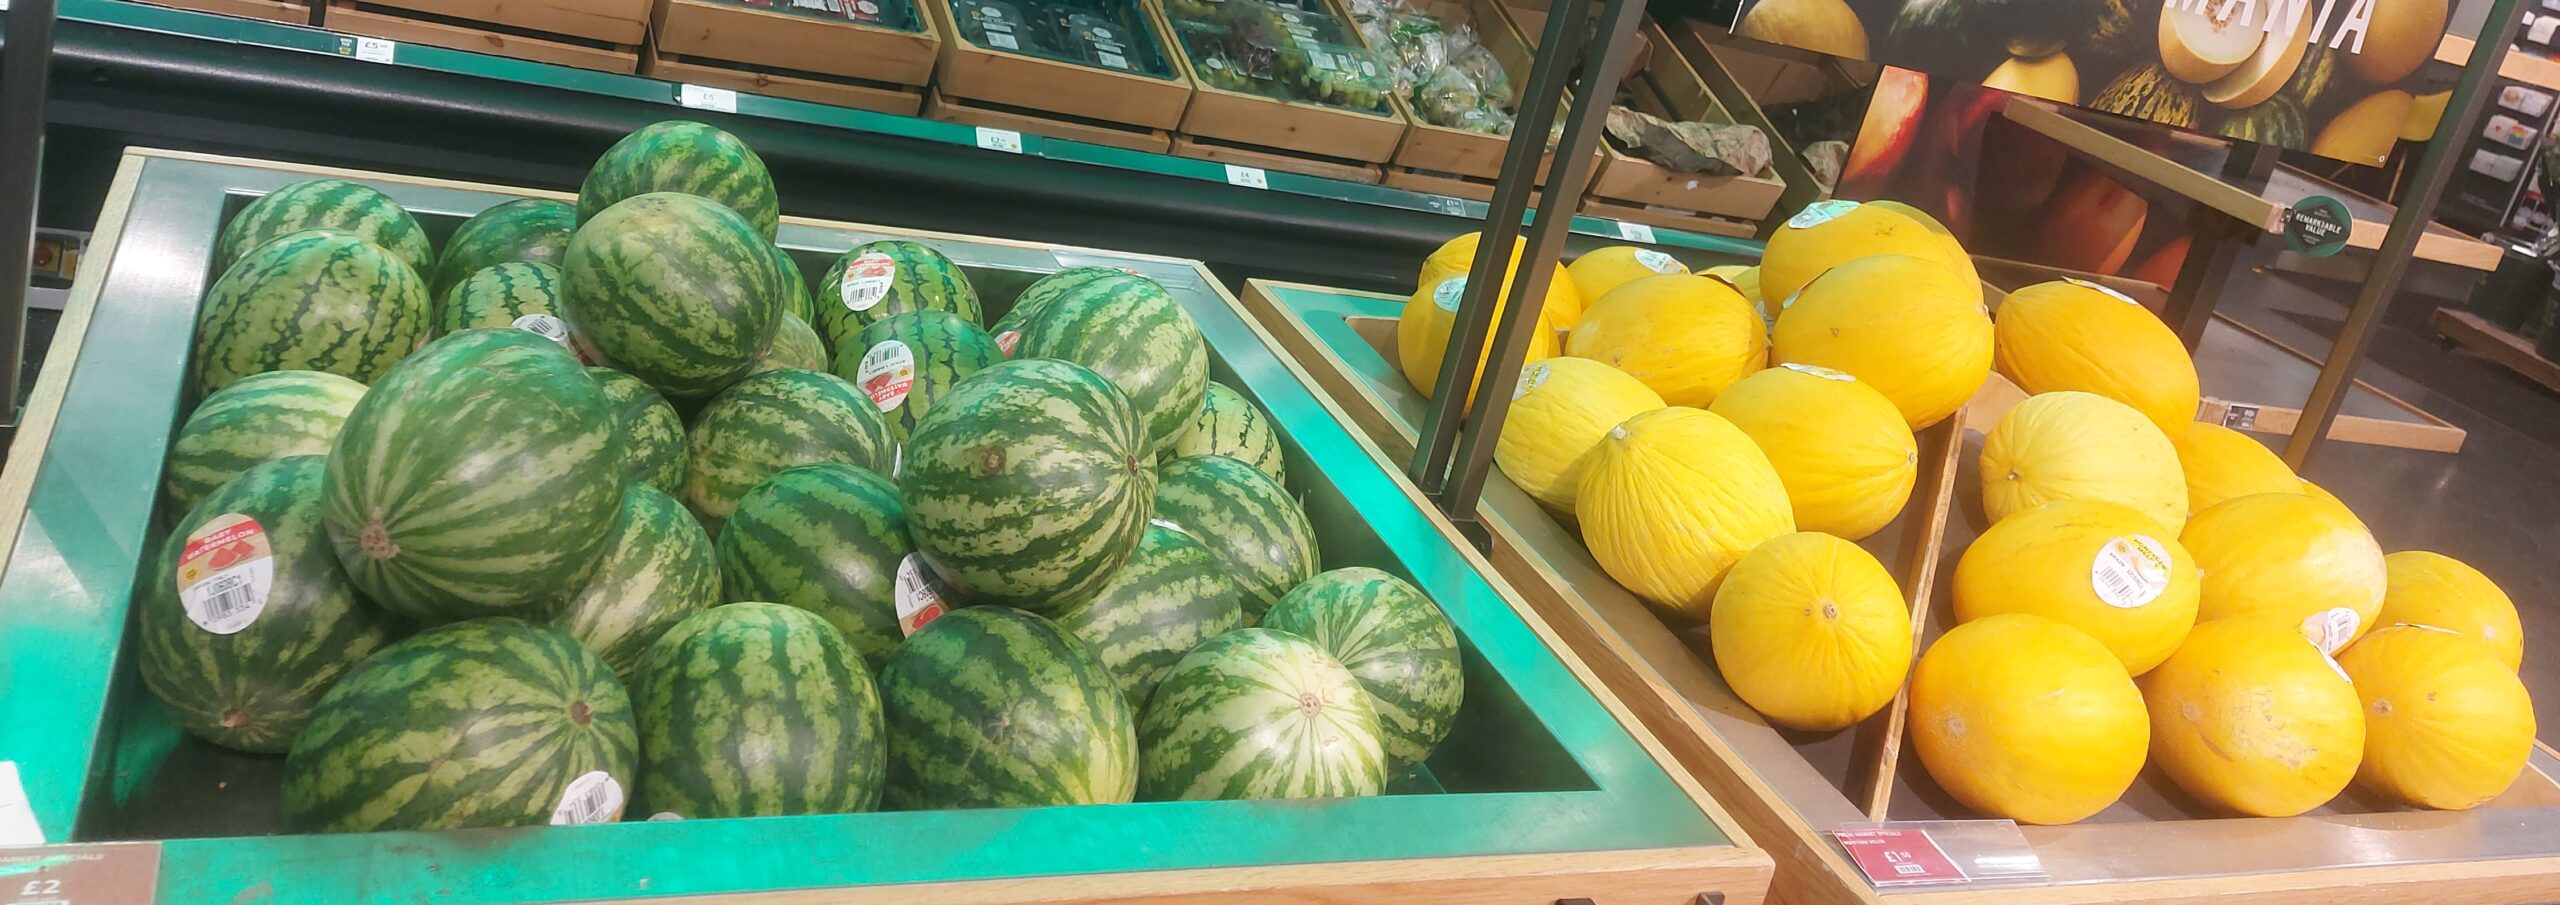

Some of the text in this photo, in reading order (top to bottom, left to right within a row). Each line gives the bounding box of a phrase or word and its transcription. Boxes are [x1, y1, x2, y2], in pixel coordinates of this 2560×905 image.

[2166, 0, 2376, 55] NIA
[2295, 213, 2342, 234] REMARKABLE
[2305, 224, 2327, 237] VALUE
[187, 529, 255, 560] WATERMELON
[204, 528, 232, 544] BABY
[20, 879, 61, 896] £2
